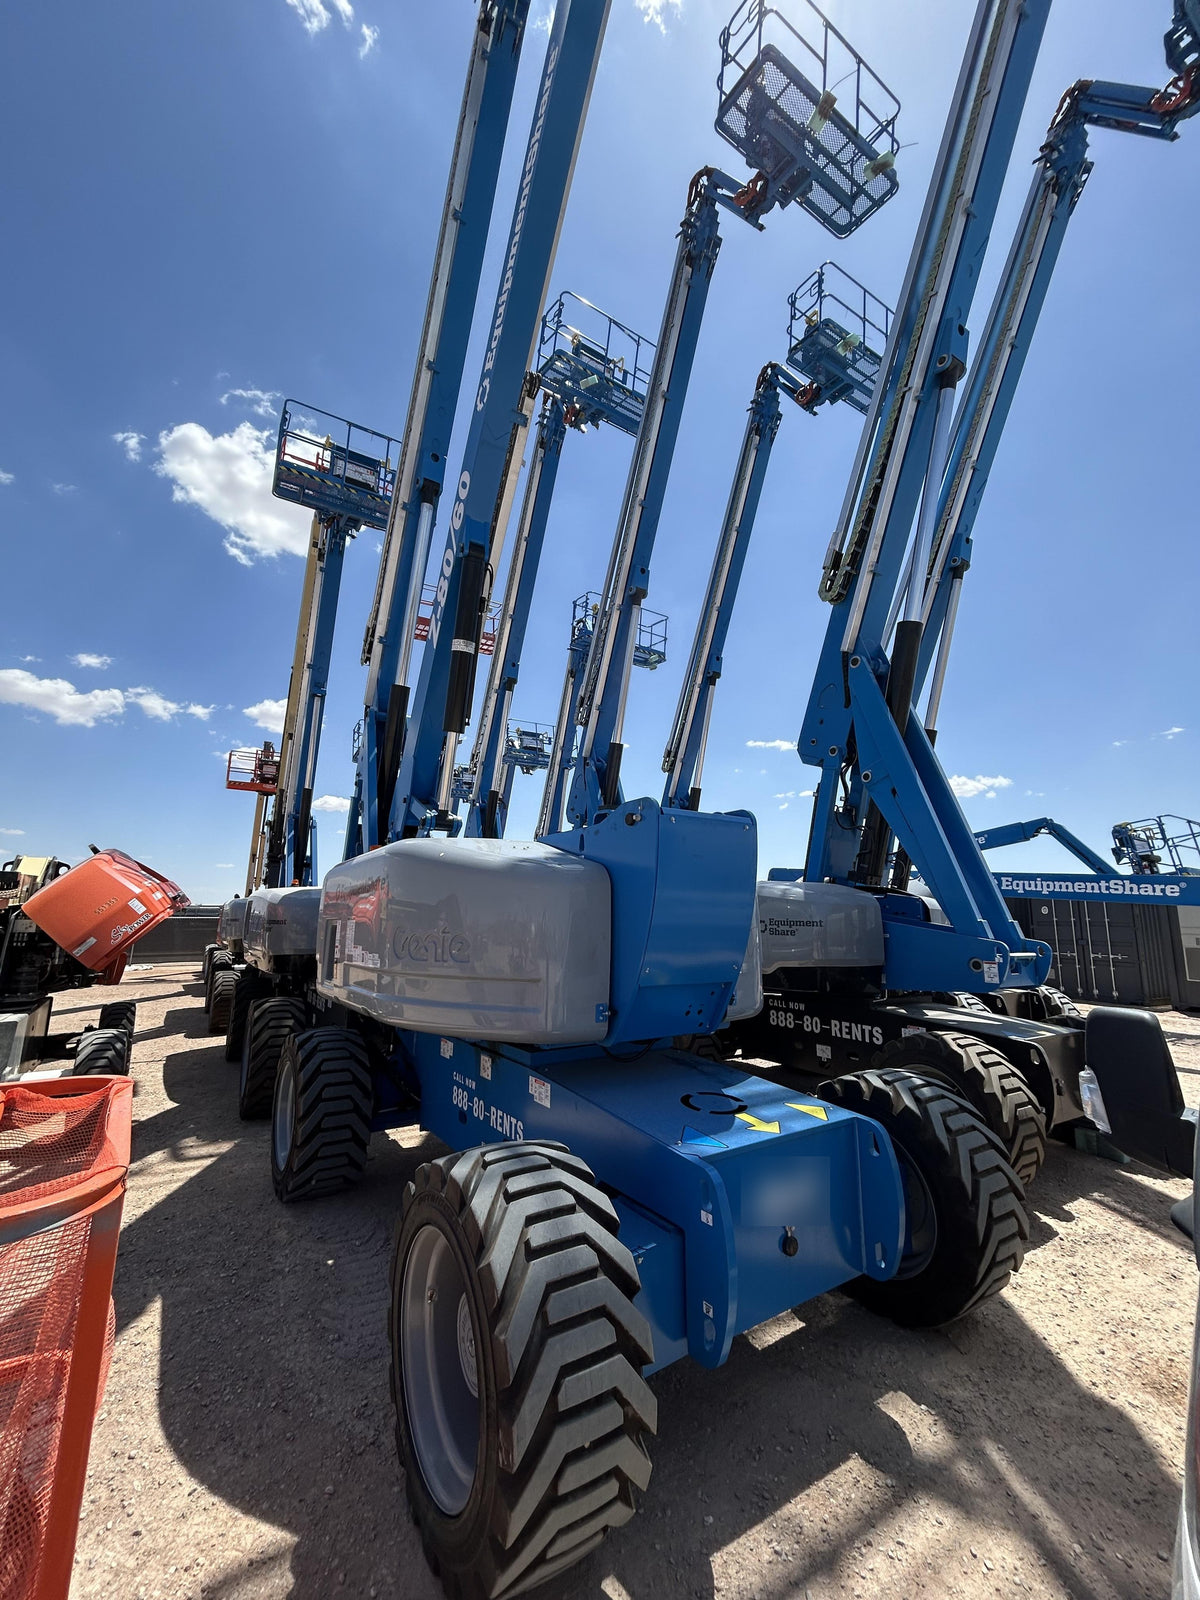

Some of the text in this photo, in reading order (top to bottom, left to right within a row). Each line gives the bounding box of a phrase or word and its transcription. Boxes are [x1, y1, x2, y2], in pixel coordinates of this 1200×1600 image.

[428, 470, 471, 649] Z-80/60
[768, 918, 824, 928] Equipment
[768, 999, 805, 1011] CALL NOW
[769, 1009, 883, 1045] 888-80-RENTS
[453, 1071, 476, 1090] CALL NOW
[452, 1085, 524, 1141] 888-80-RENTS
